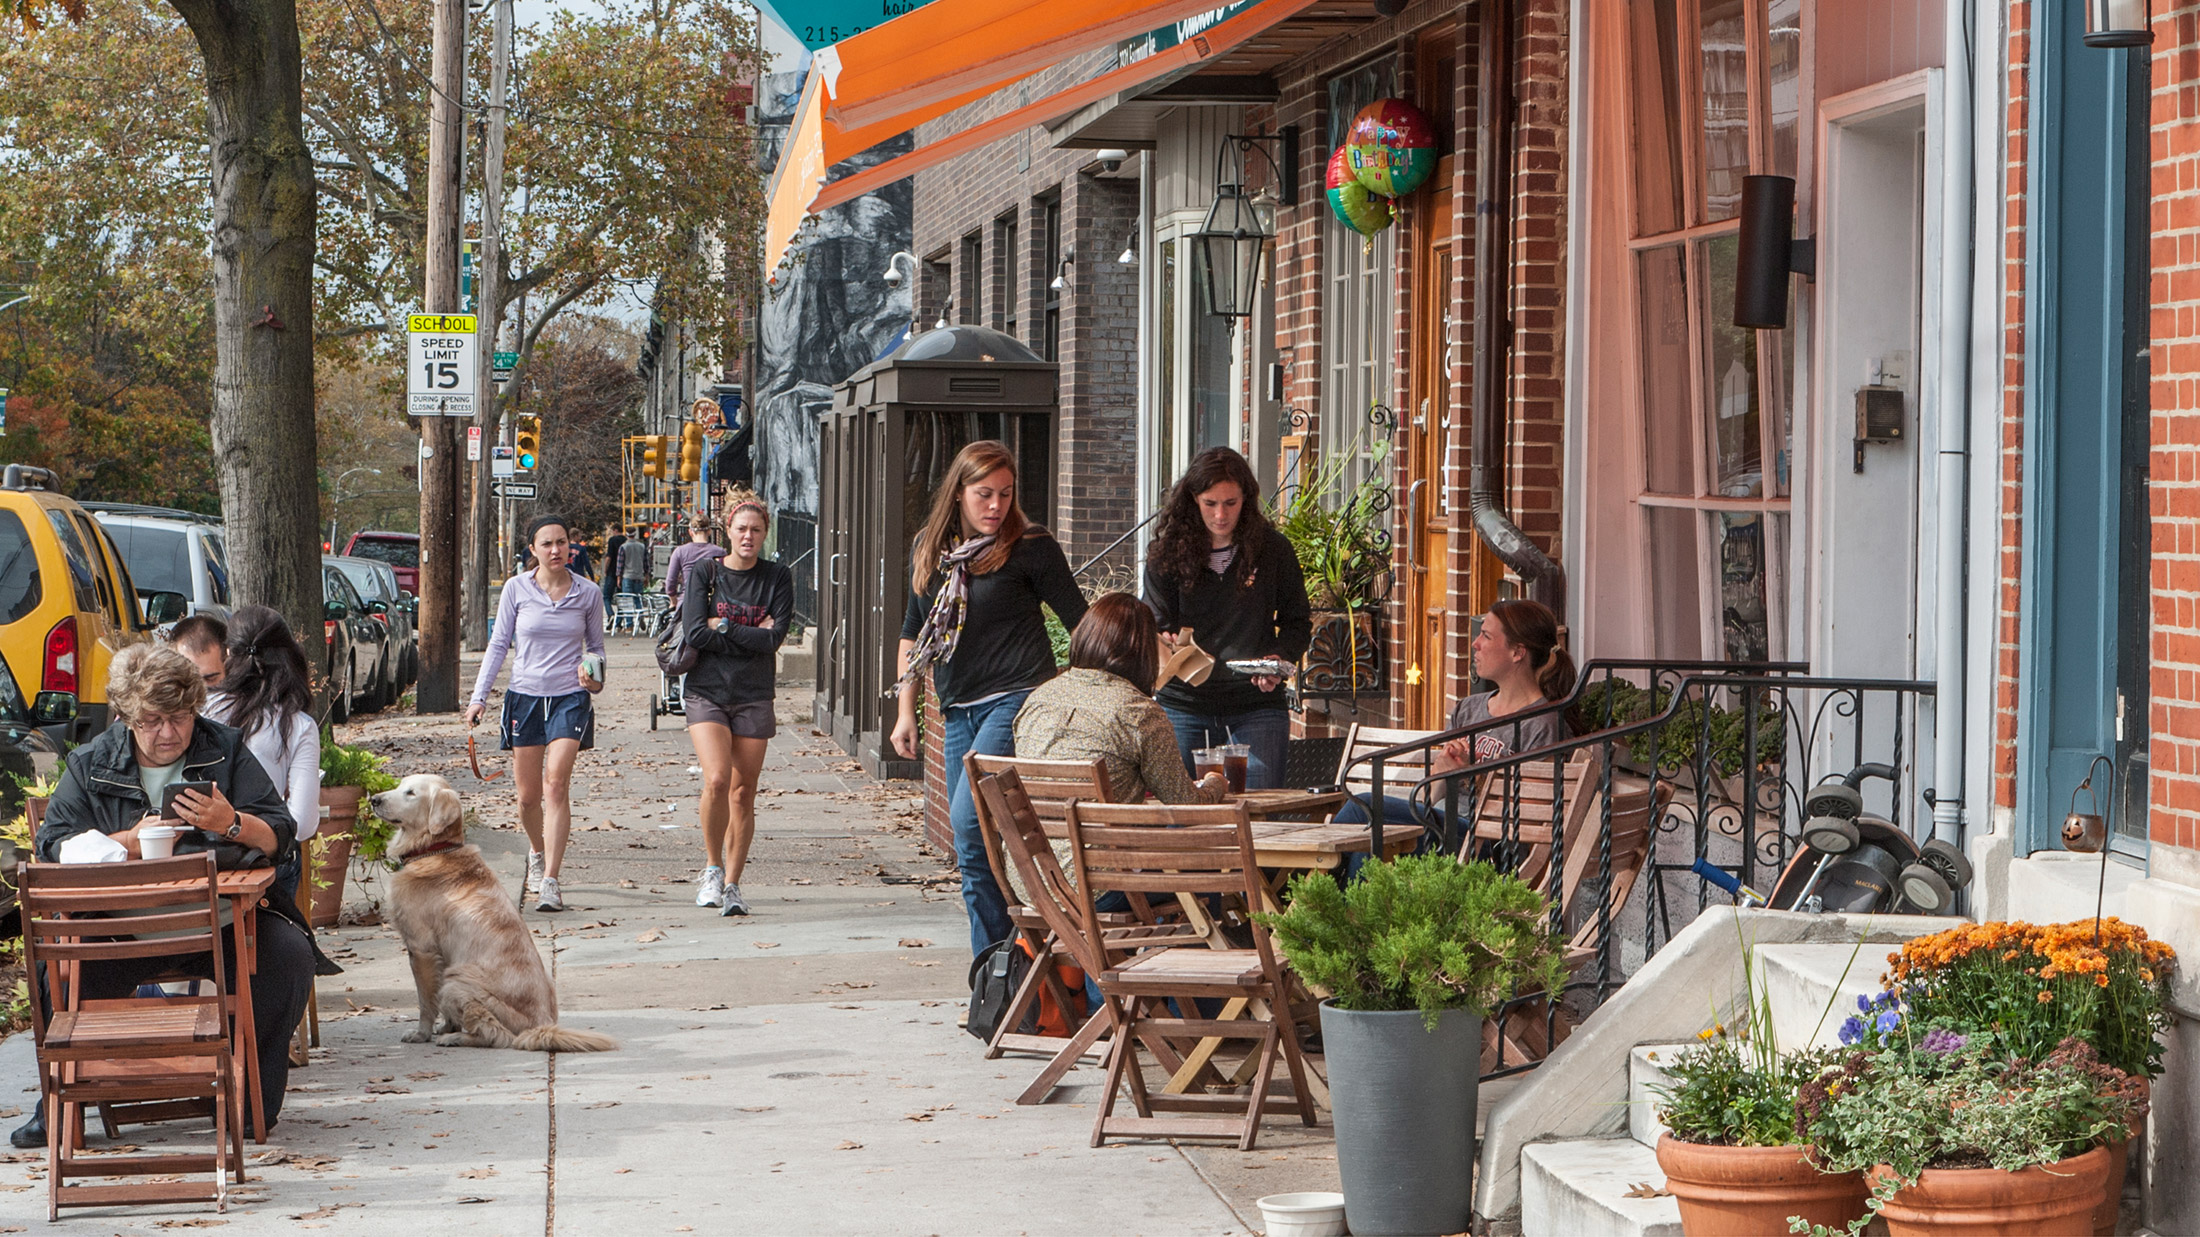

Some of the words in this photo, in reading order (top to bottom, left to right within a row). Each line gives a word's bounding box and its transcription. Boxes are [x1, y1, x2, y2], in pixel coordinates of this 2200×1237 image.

[414, 317, 471, 331] SCHOOL
[421, 338, 464, 348] SPEED
[424, 350, 460, 360] LIMIT
[424, 362, 460, 389] 15
[413, 395, 439, 403] DURING
[441, 395, 470, 404] OPENING
